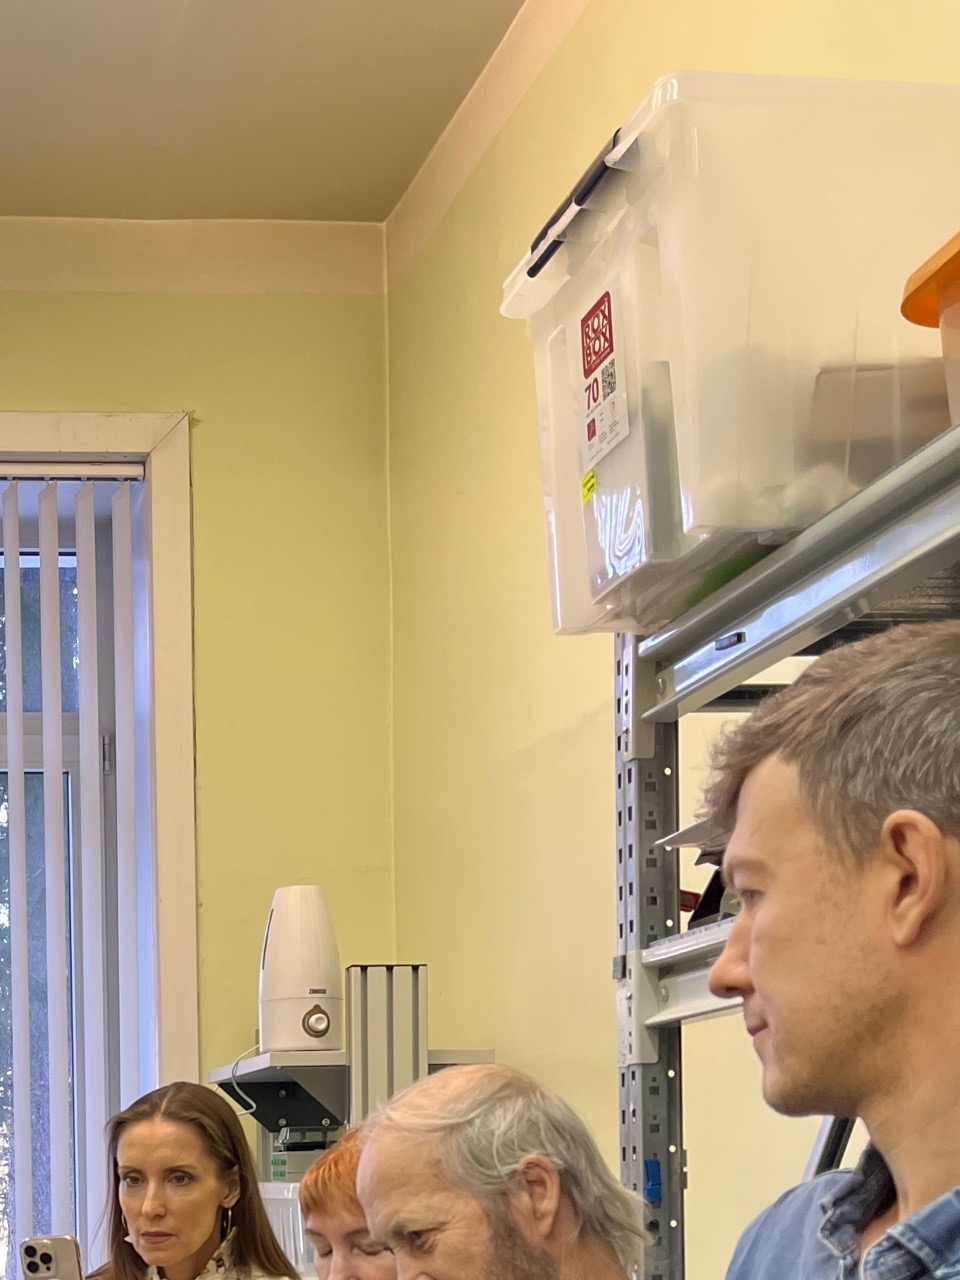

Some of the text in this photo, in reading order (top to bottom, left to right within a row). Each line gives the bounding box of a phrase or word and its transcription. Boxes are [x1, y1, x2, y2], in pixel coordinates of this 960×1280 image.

[584, 303, 609, 346] ROX
[585, 325, 611, 368] BOX
[584, 377, 599, 410] 70
